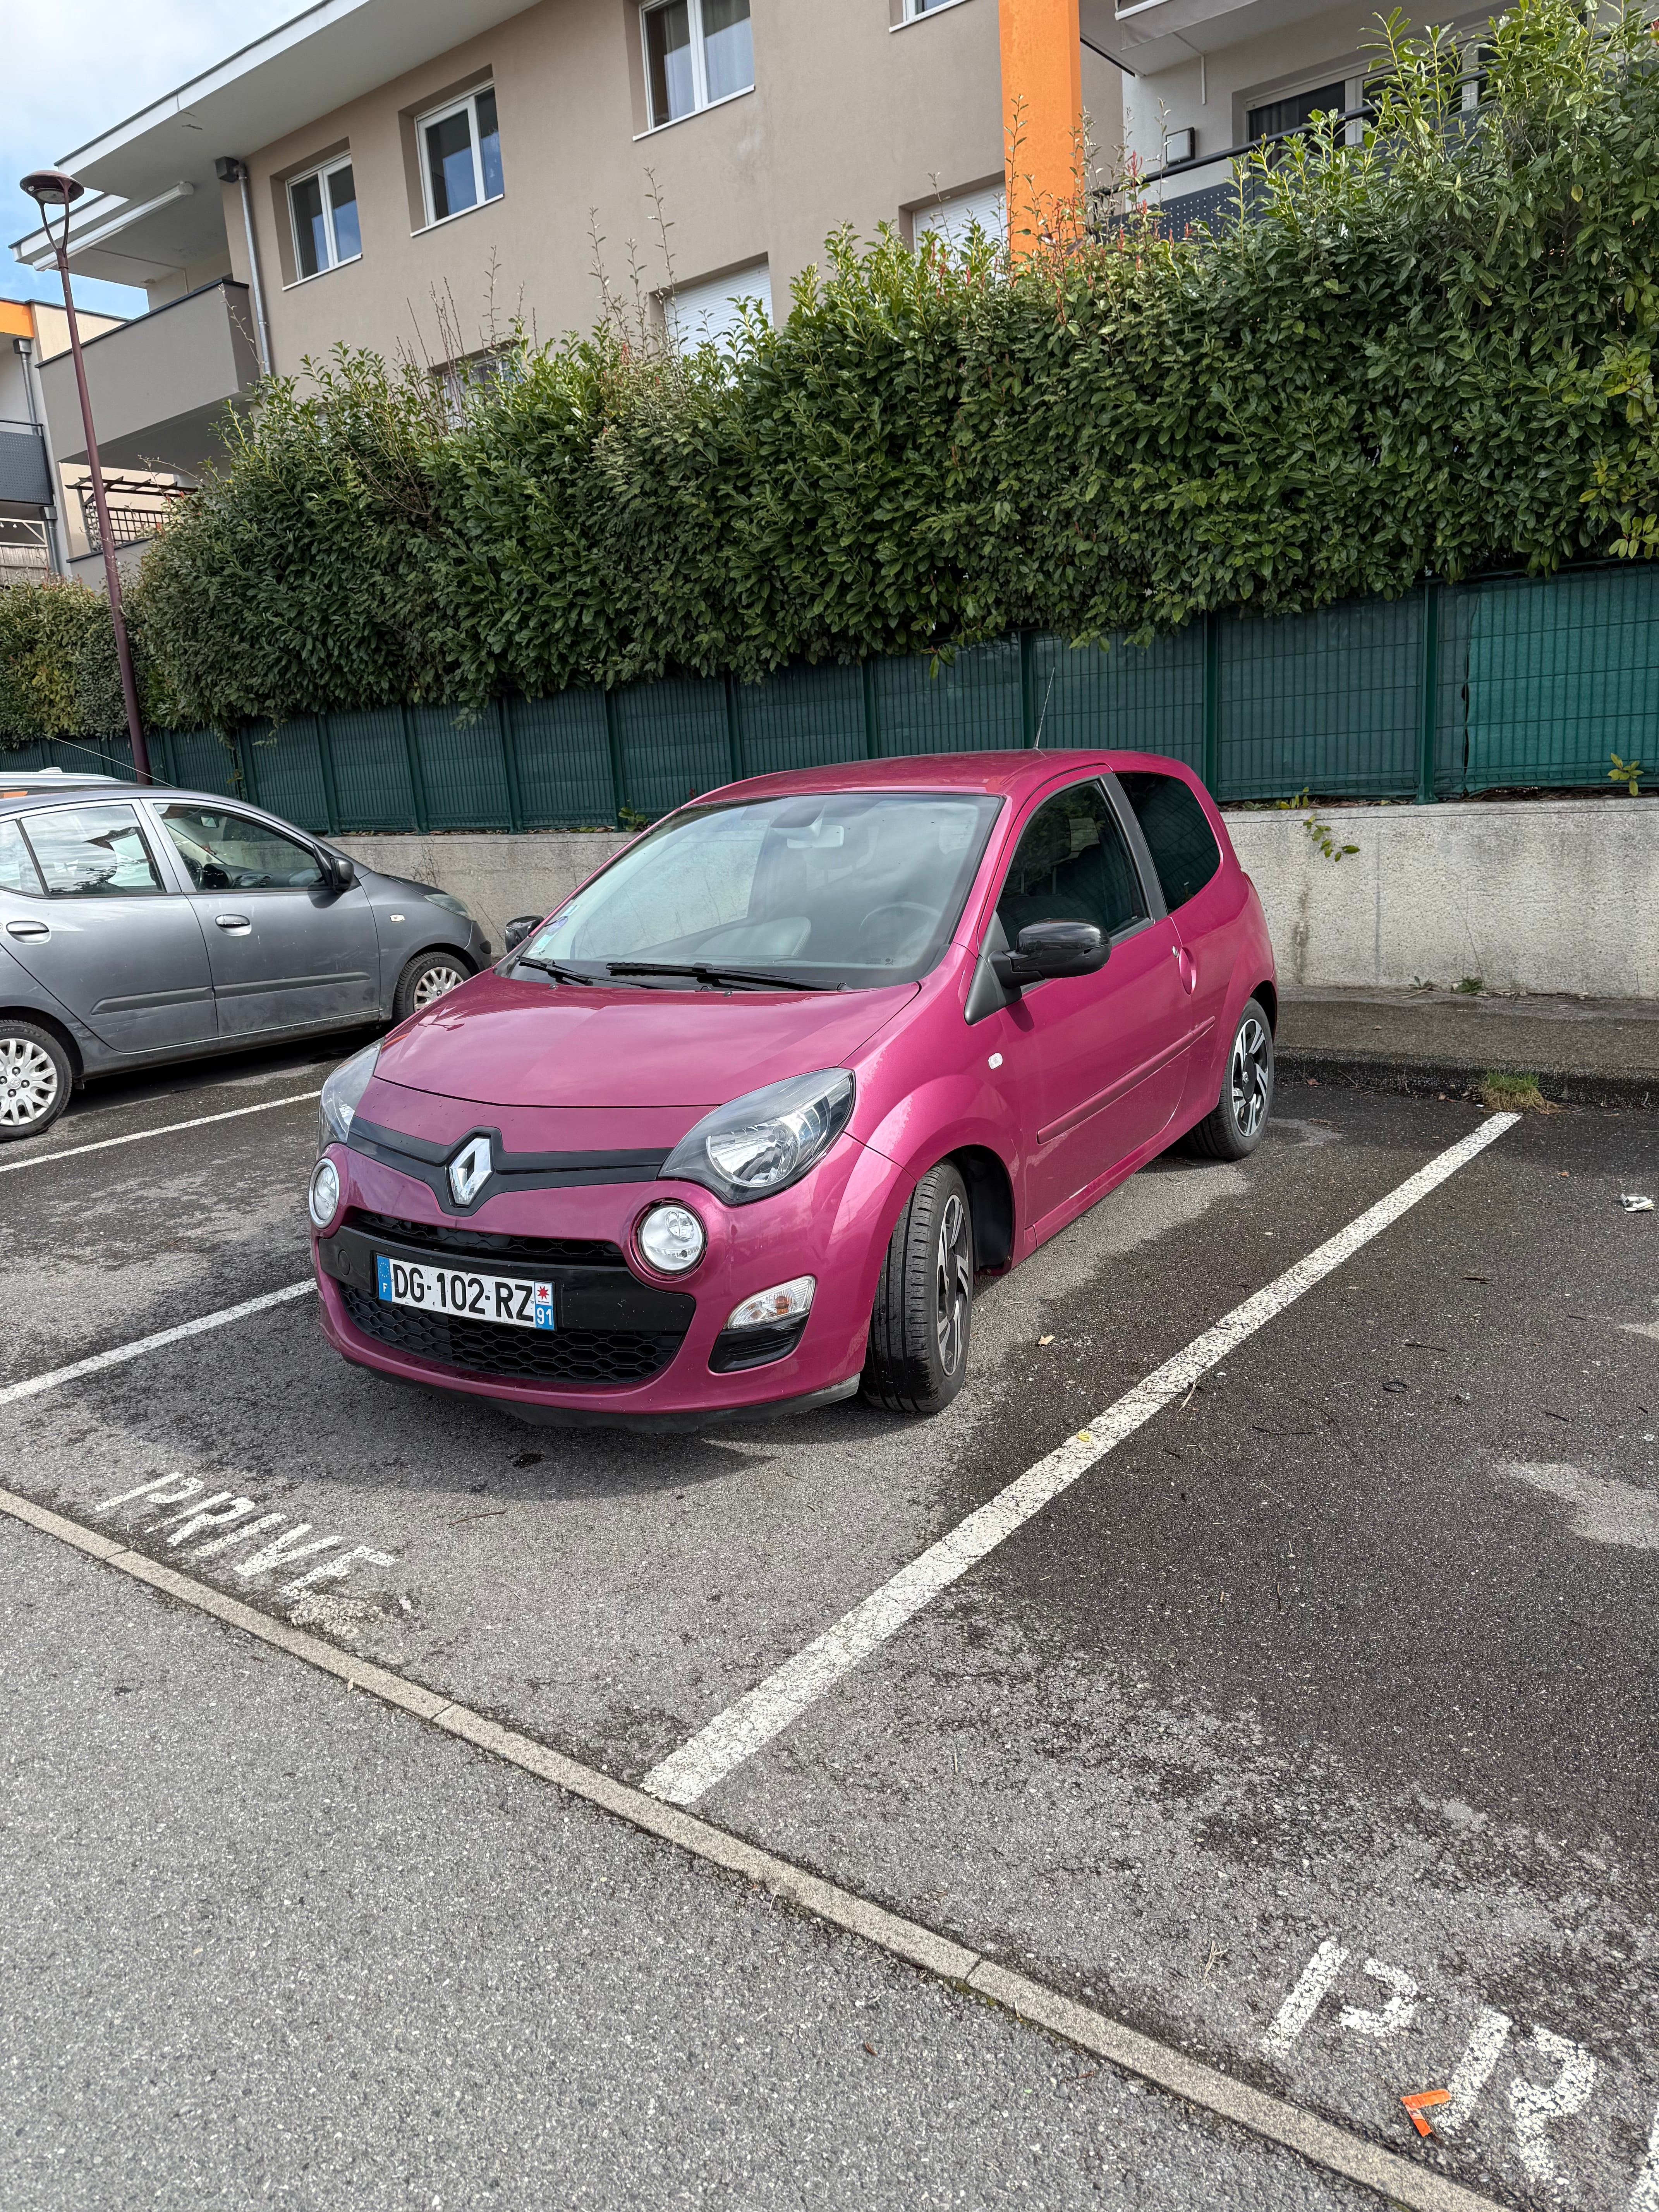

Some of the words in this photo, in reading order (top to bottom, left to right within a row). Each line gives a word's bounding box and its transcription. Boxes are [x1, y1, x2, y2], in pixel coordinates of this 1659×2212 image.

[383, 1283, 388, 1293] F
[392, 1263, 534, 1322] DG-102-RZ
[536, 1307, 553, 1326] 91
